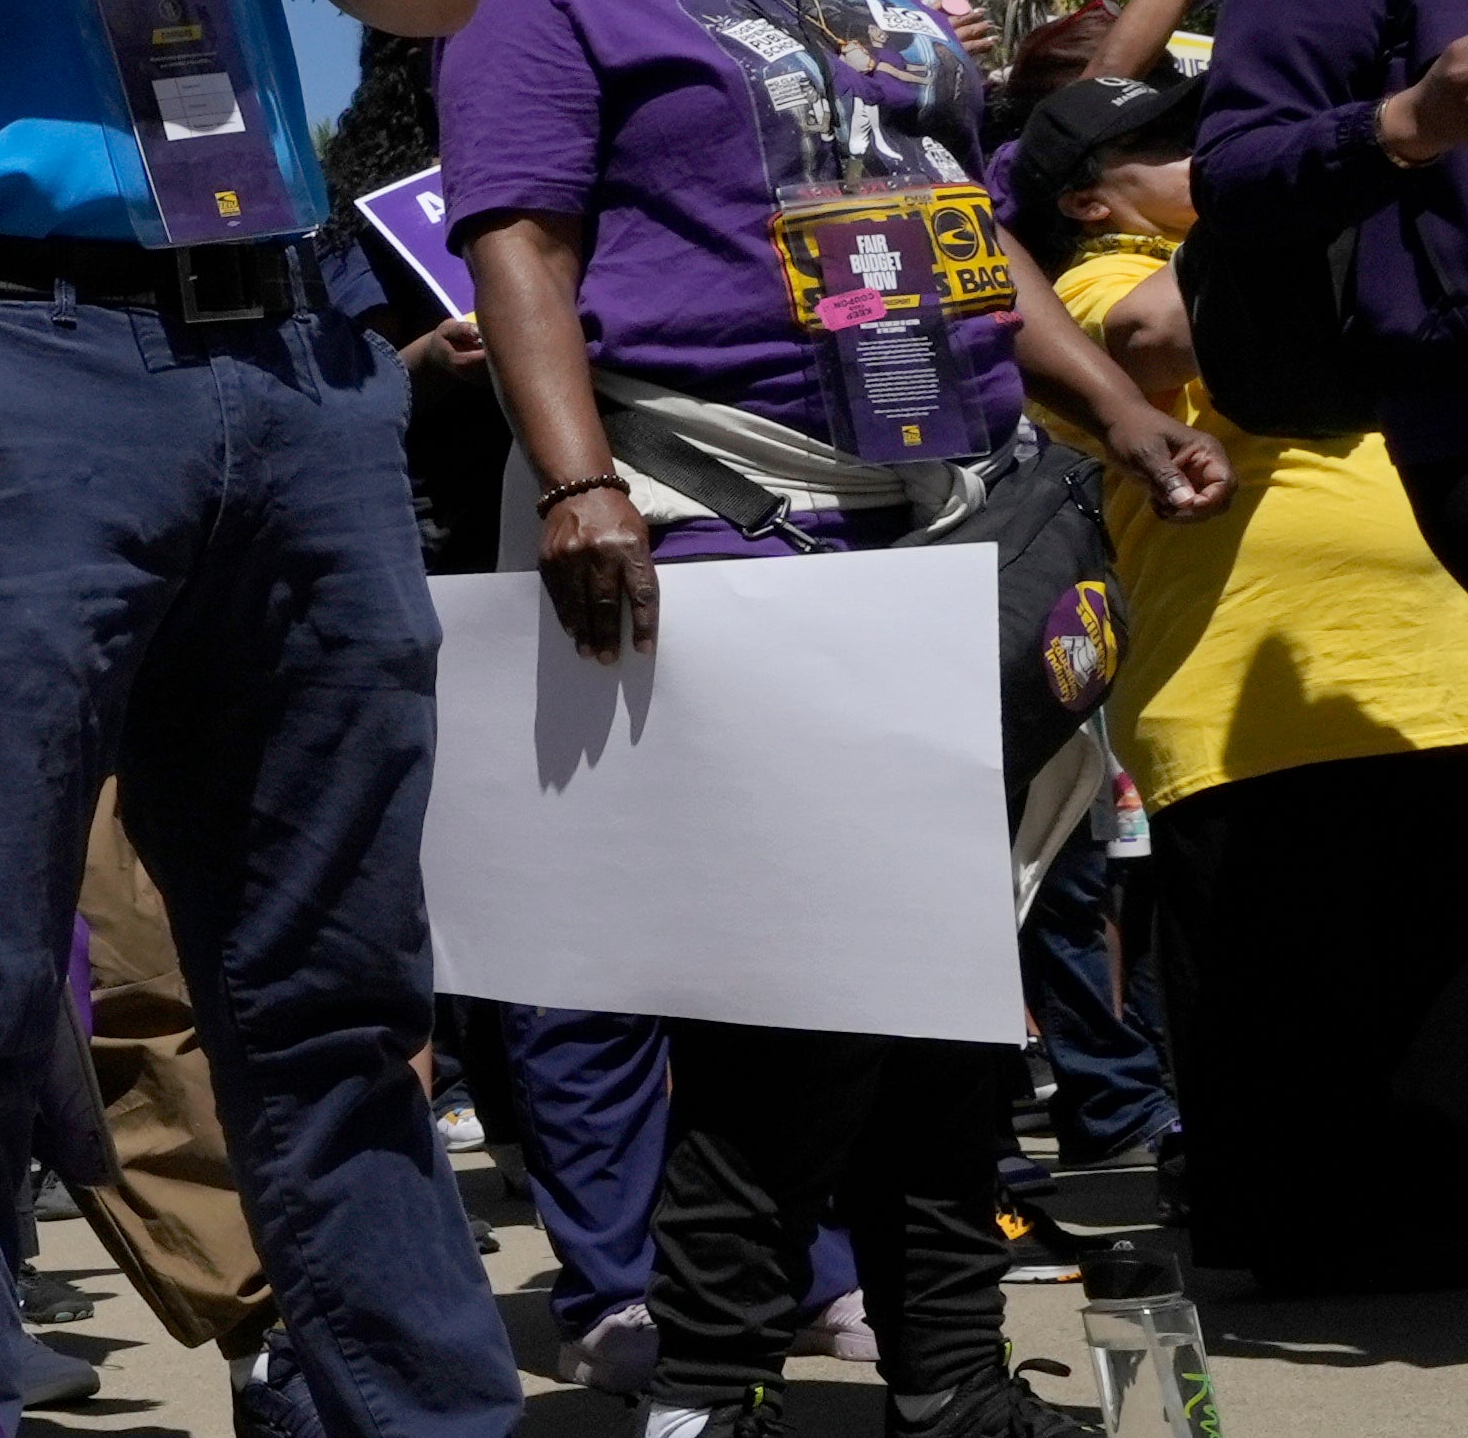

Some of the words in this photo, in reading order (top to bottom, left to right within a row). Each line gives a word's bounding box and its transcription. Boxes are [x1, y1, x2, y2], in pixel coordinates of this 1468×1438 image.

[856, 234, 889, 254] FAIR
[849, 251, 902, 274] BUDGET
[862, 271, 898, 291] NOW
